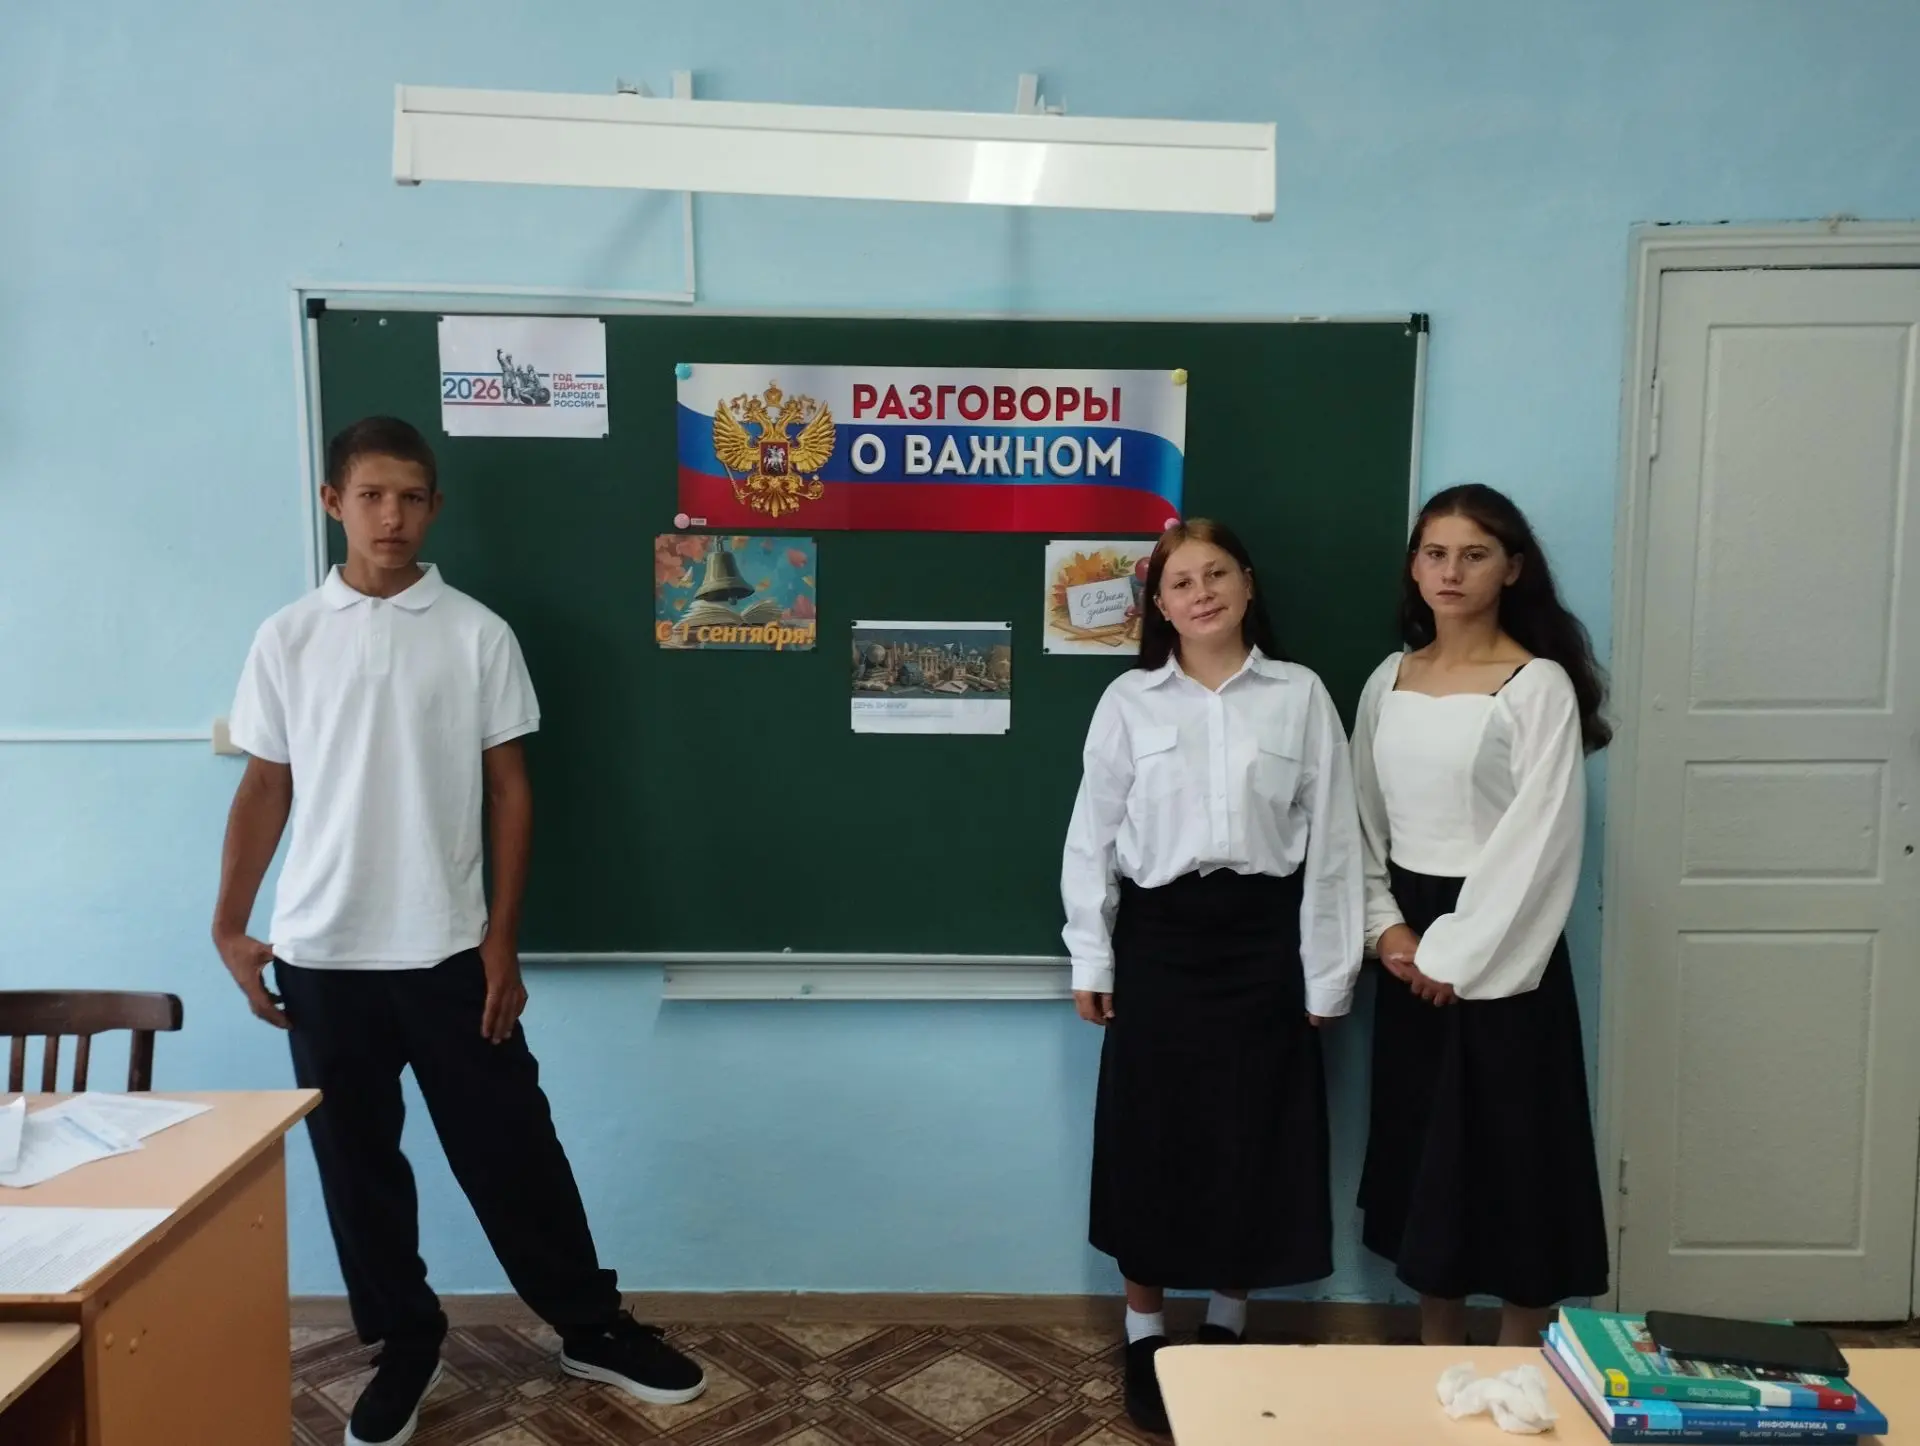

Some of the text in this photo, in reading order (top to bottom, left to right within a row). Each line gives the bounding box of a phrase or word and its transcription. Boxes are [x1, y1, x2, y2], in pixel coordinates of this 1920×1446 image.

[553, 373, 573, 382] ГОД
[442, 377, 501, 400] 2026
[553, 382, 605, 391] ЕДИНСТВА
[553, 391, 600, 400] НАРОДОВ
[553, 400, 595, 408] РОССИИ
[852, 384, 1121, 422] РАЗГОВОРЫ
[850, 433, 1122, 477] О ВАЖНОМ
[1080, 592, 1092, 609] С
[656, 620, 815, 651] С 1 сентября!
[1757, 1420, 1828, 1431] ИНФОРМАТИКА
